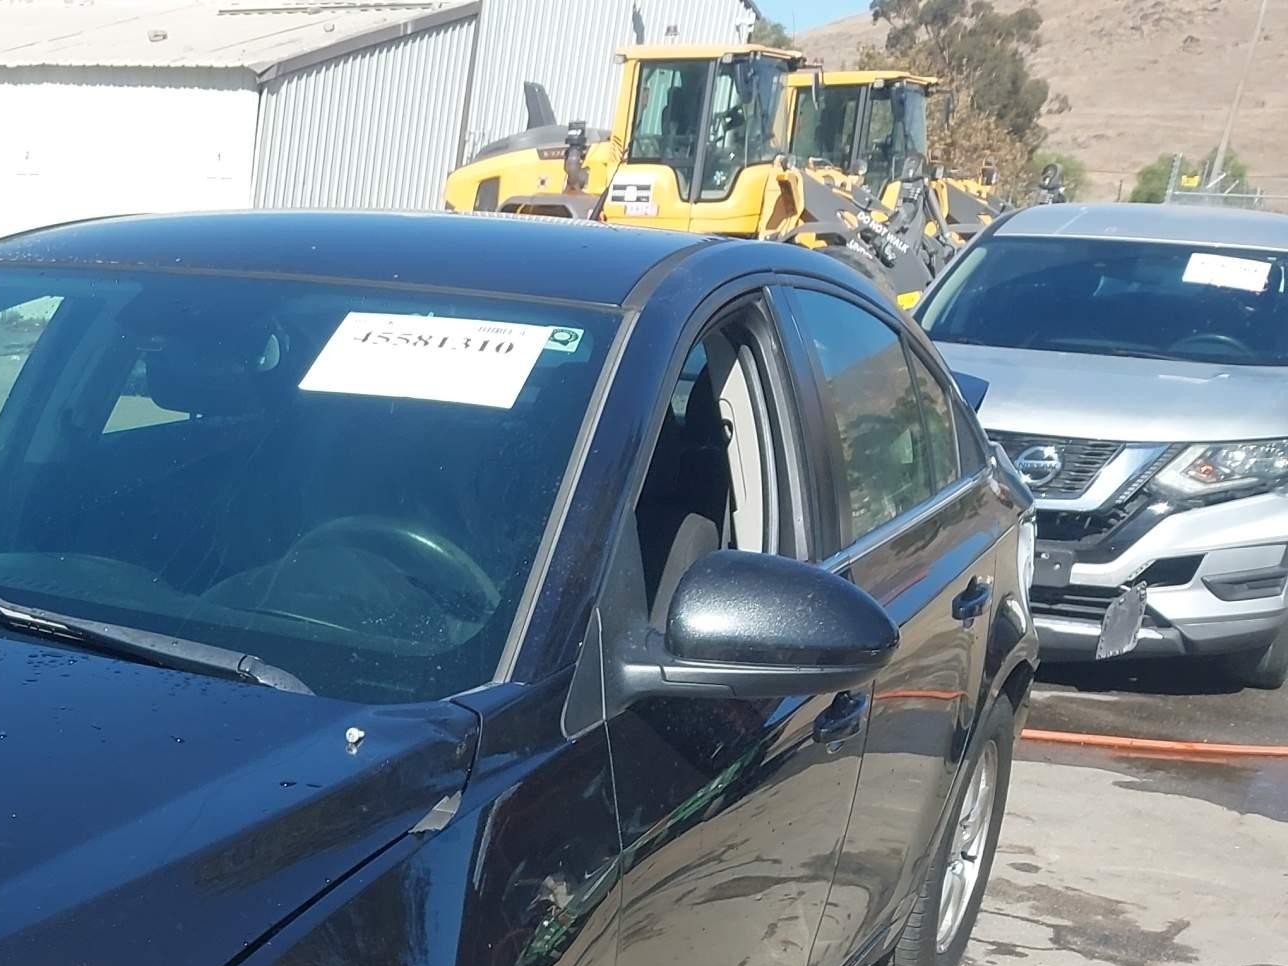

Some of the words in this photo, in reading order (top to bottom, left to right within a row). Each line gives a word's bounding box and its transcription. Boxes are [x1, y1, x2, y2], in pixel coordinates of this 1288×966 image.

[857, 211, 871, 224] DO
[869, 220, 889, 236] NOT
[886, 232, 910, 253] WALK
[353, 331, 515, 354] 45581310
